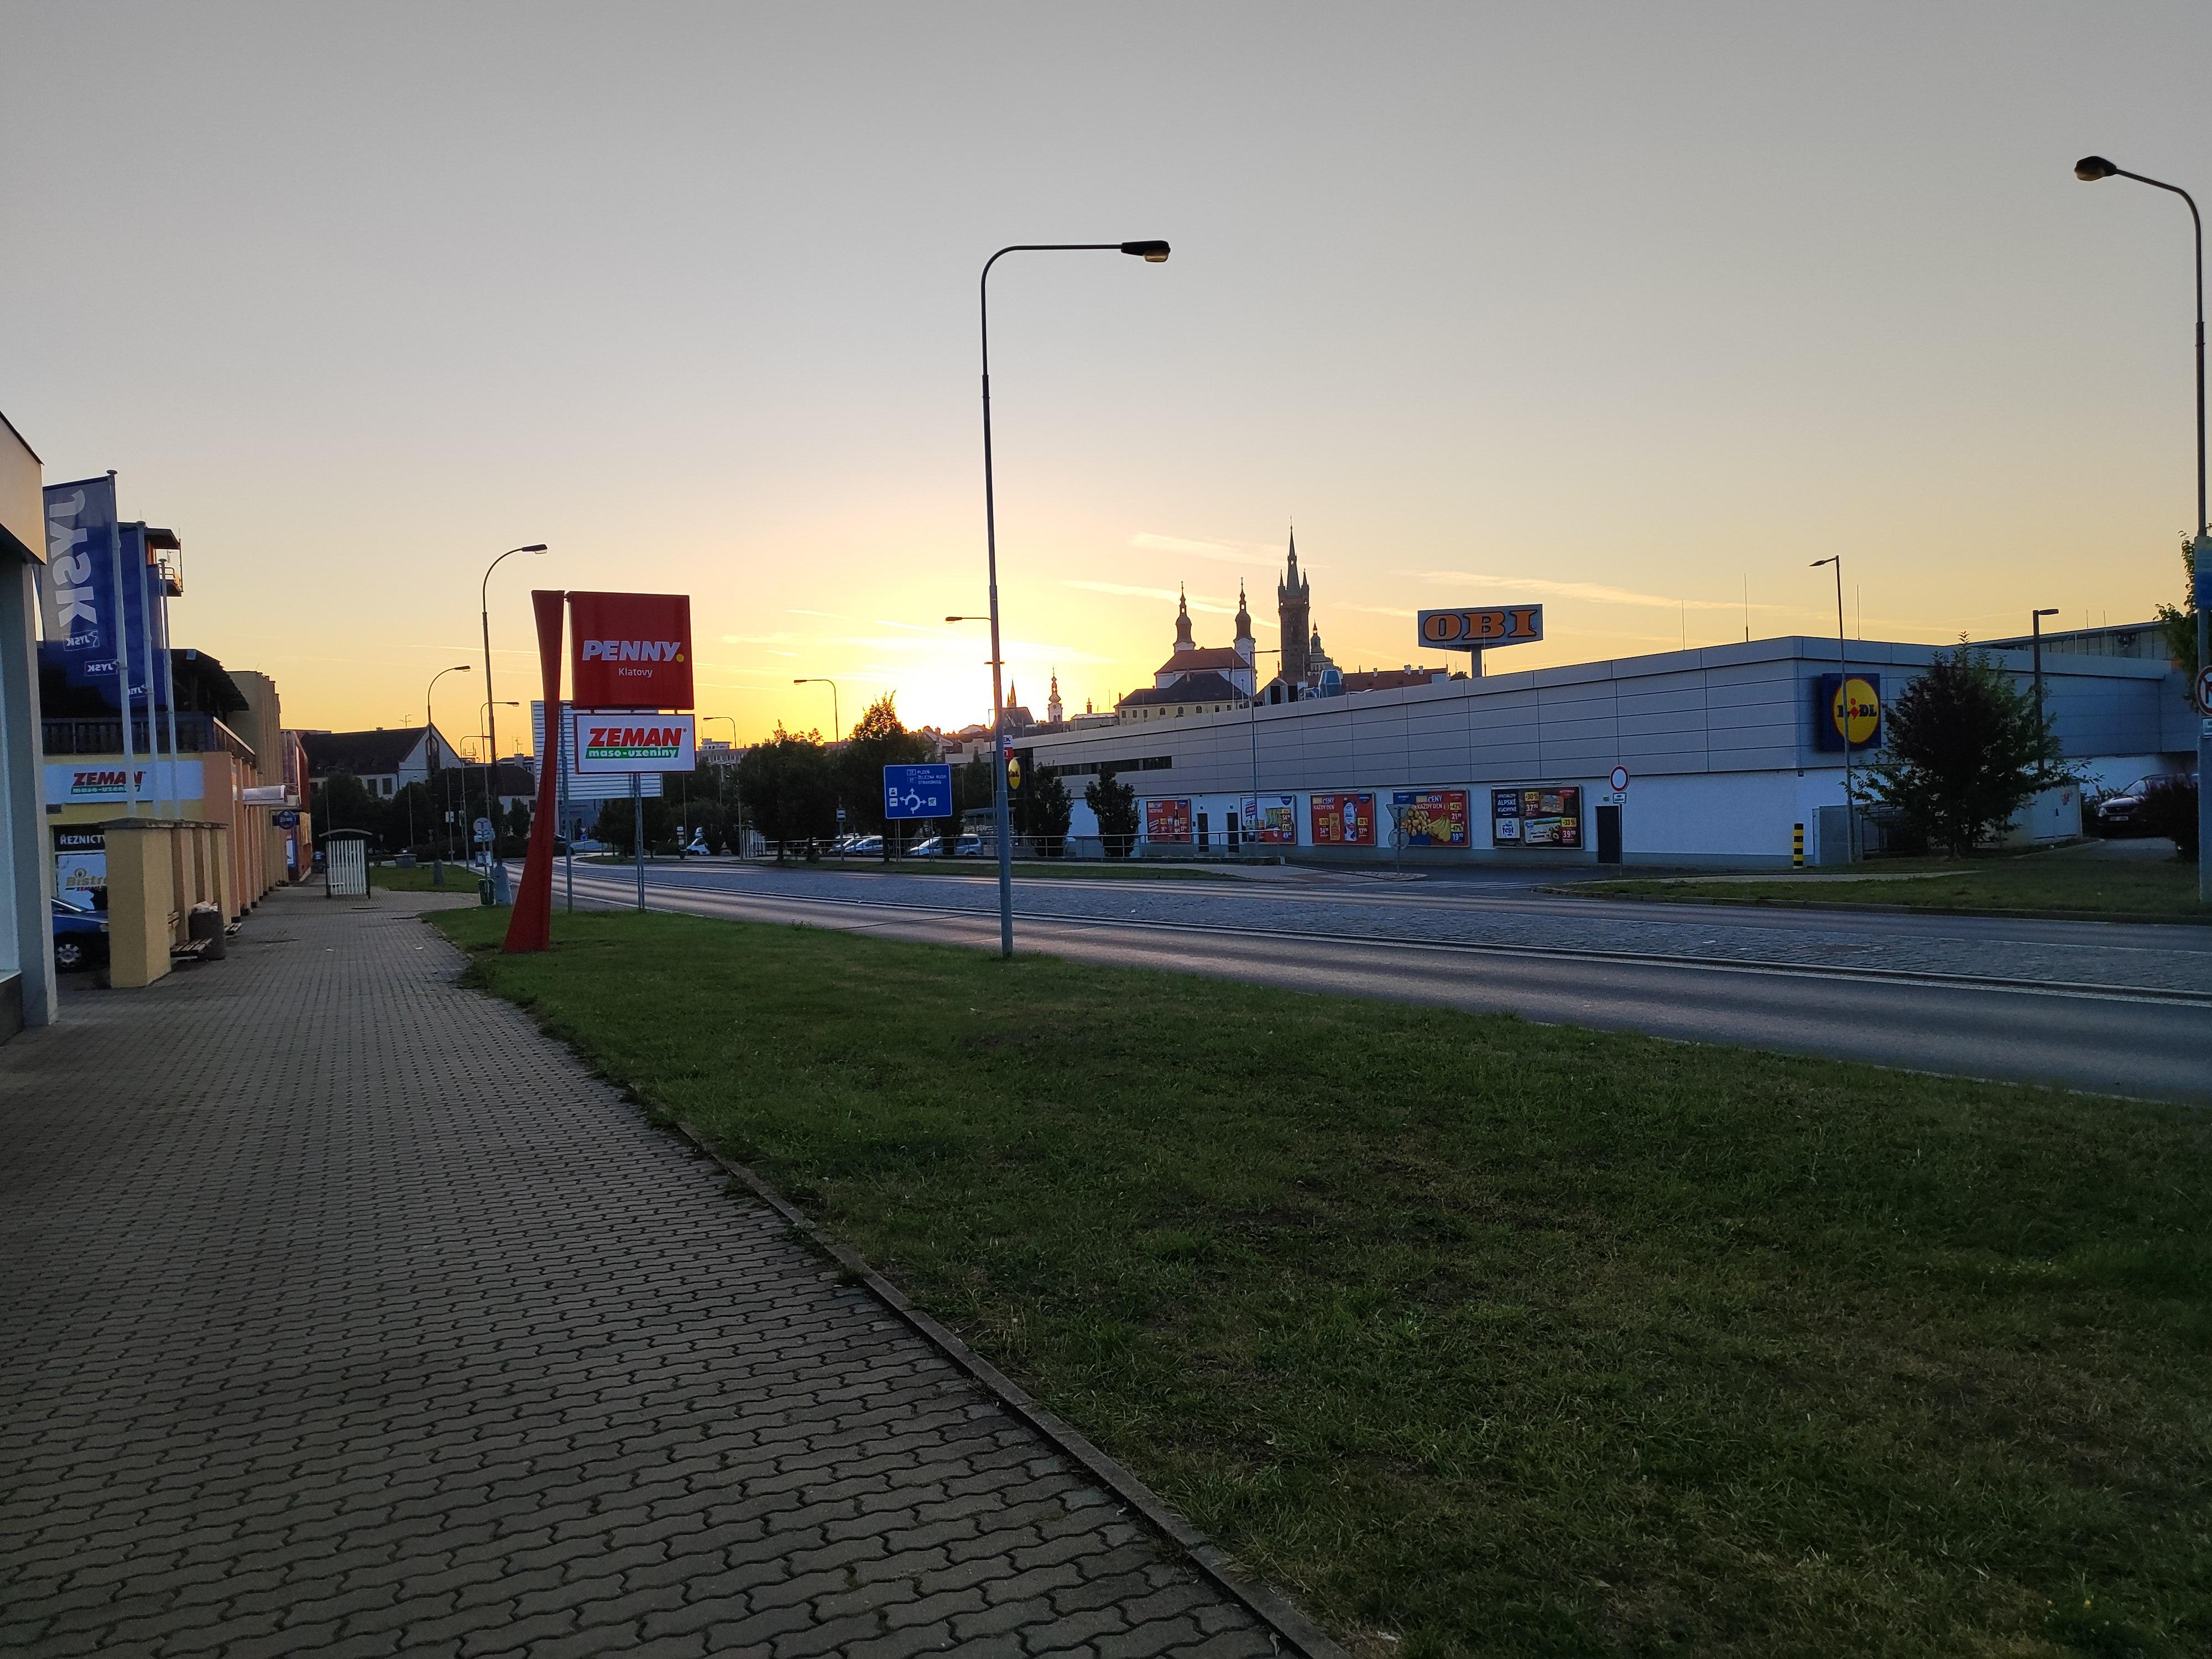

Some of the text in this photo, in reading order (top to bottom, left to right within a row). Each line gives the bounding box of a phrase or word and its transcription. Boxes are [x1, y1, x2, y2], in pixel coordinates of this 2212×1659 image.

[1423, 609, 1538, 642] OBI
[618, 667, 653, 678] Klatovy
[588, 727, 682, 747] ZEMAN
